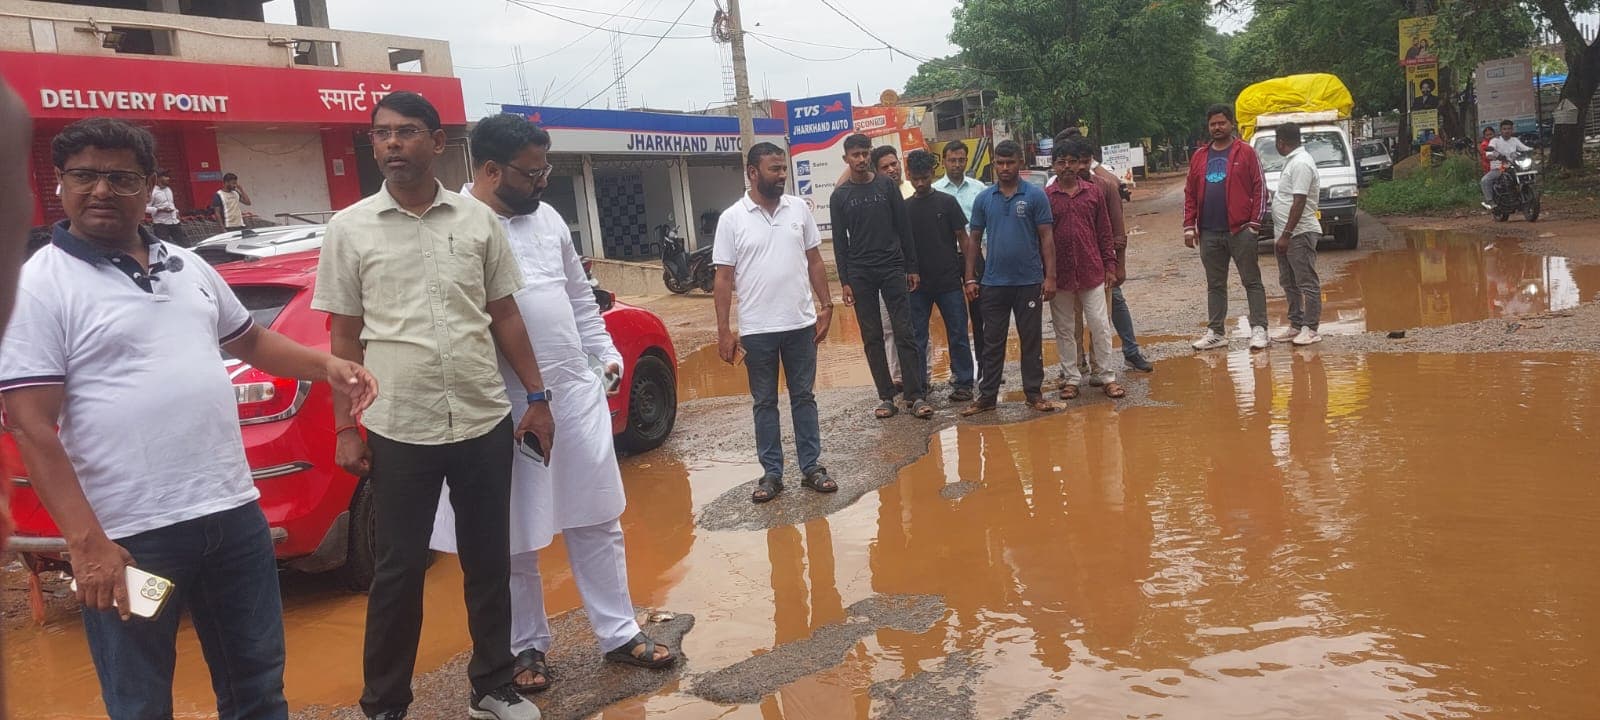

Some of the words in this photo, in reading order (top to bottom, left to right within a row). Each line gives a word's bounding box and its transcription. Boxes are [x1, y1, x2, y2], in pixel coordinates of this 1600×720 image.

[40, 89, 157, 110] DELIVERY
[162, 93, 229, 113] POINT
[318, 83, 367, 111] स्मार्ट
[794, 105, 820, 118] TVS
[793, 122, 830, 136] JHARKHAND
[831, 119, 849, 130] AUTO
[627, 133, 708, 152] JHARKHAND
[715, 136, 743, 152] AUTO
